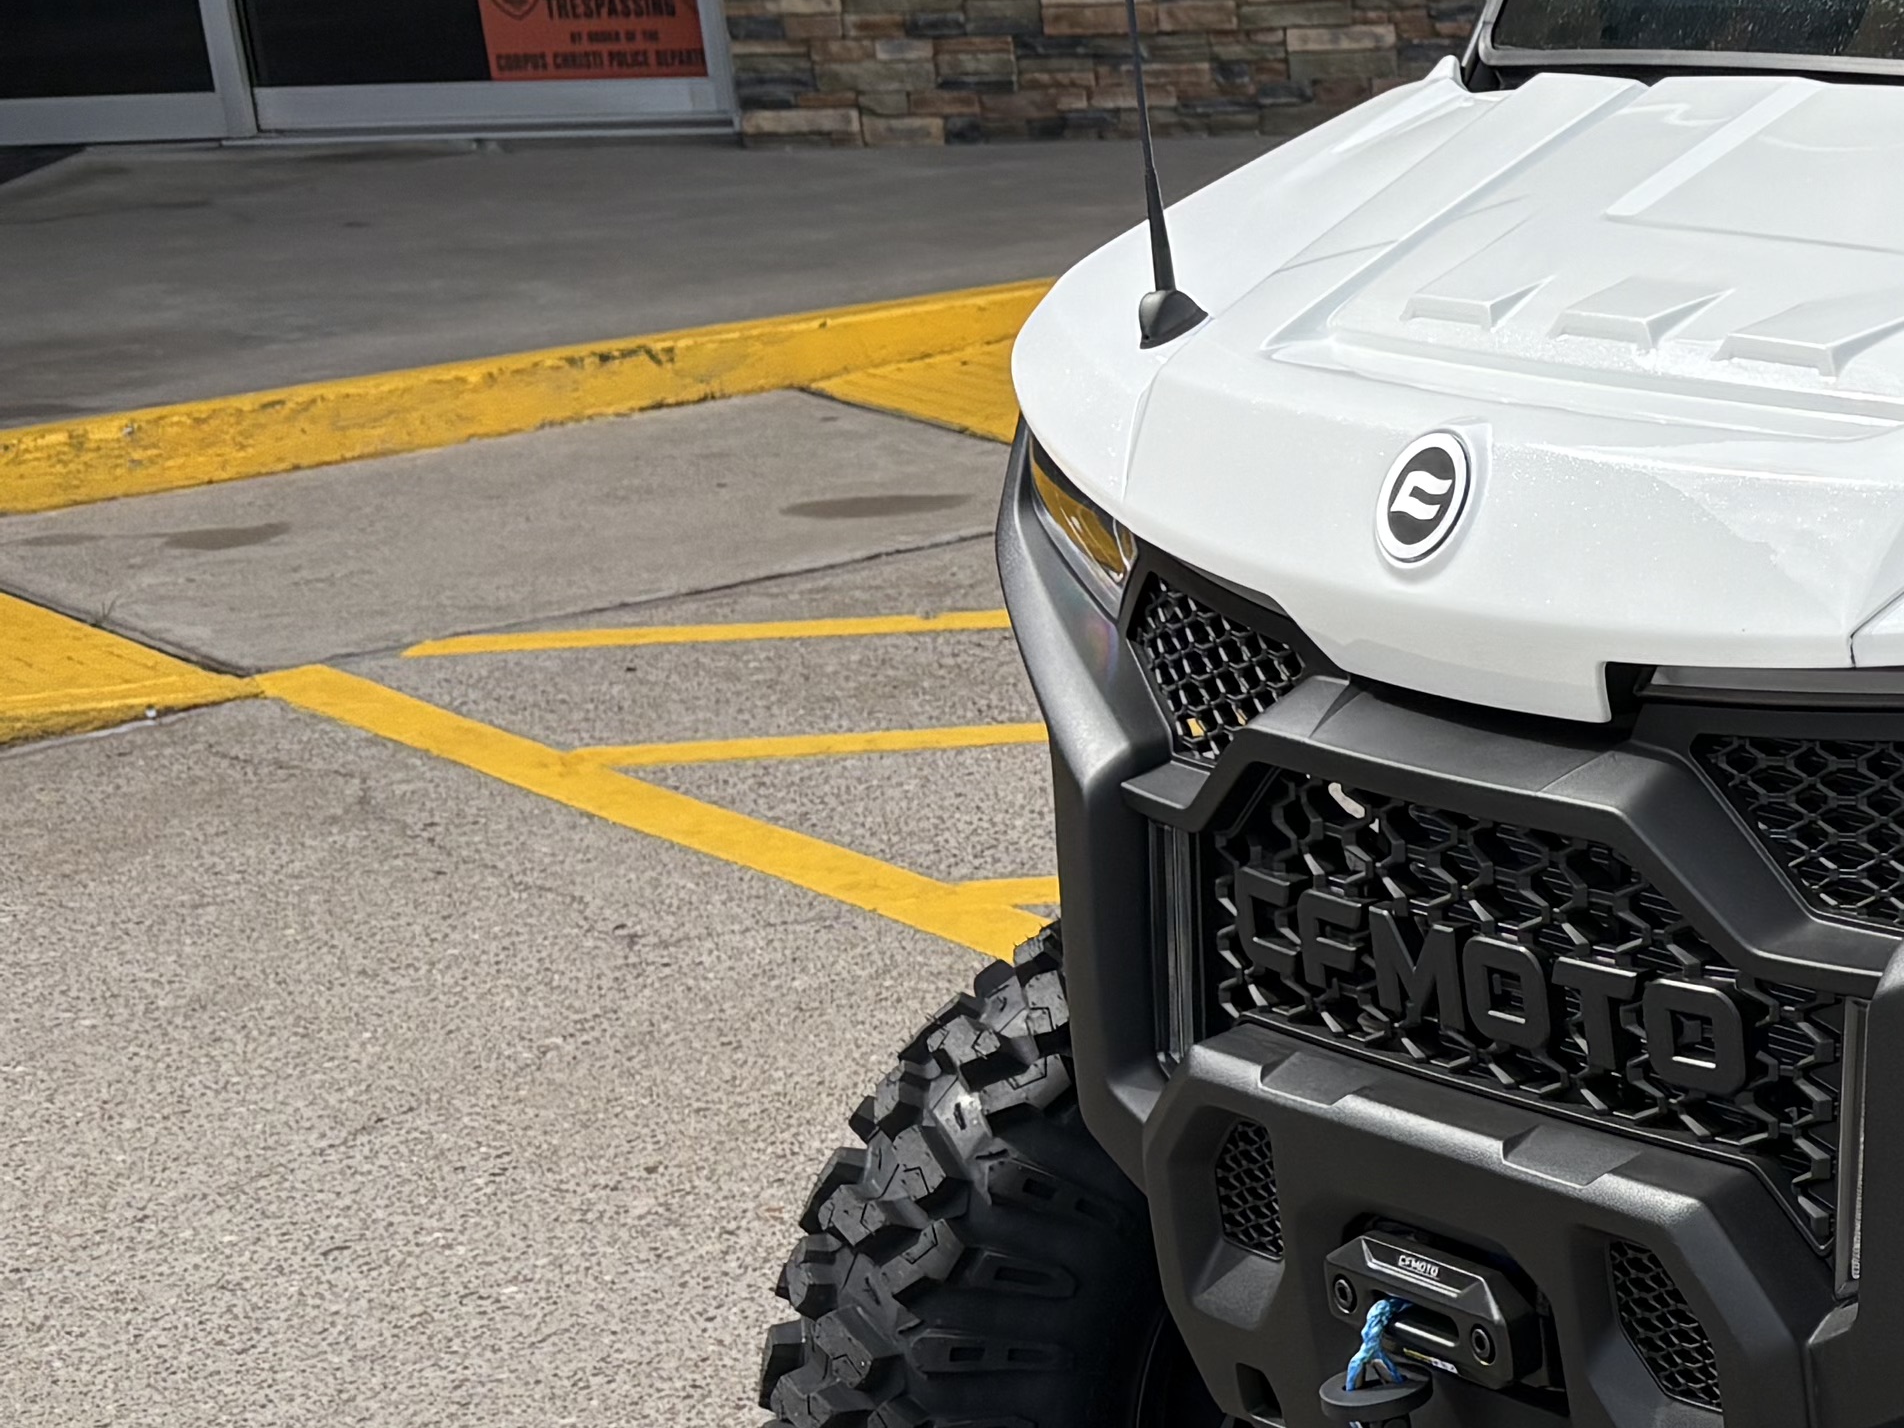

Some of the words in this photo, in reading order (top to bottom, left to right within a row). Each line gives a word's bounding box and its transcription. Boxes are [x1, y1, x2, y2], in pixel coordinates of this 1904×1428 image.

[495, 51, 548, 71] CORPUS
[552, 50, 604, 70] CHRISTI
[608, 49, 649, 69] POLICE
[655, 47, 704, 67] DEPART
[1235, 864, 1750, 1094] CFMOTO
[1397, 1253, 1441, 1278] CFMOTO
